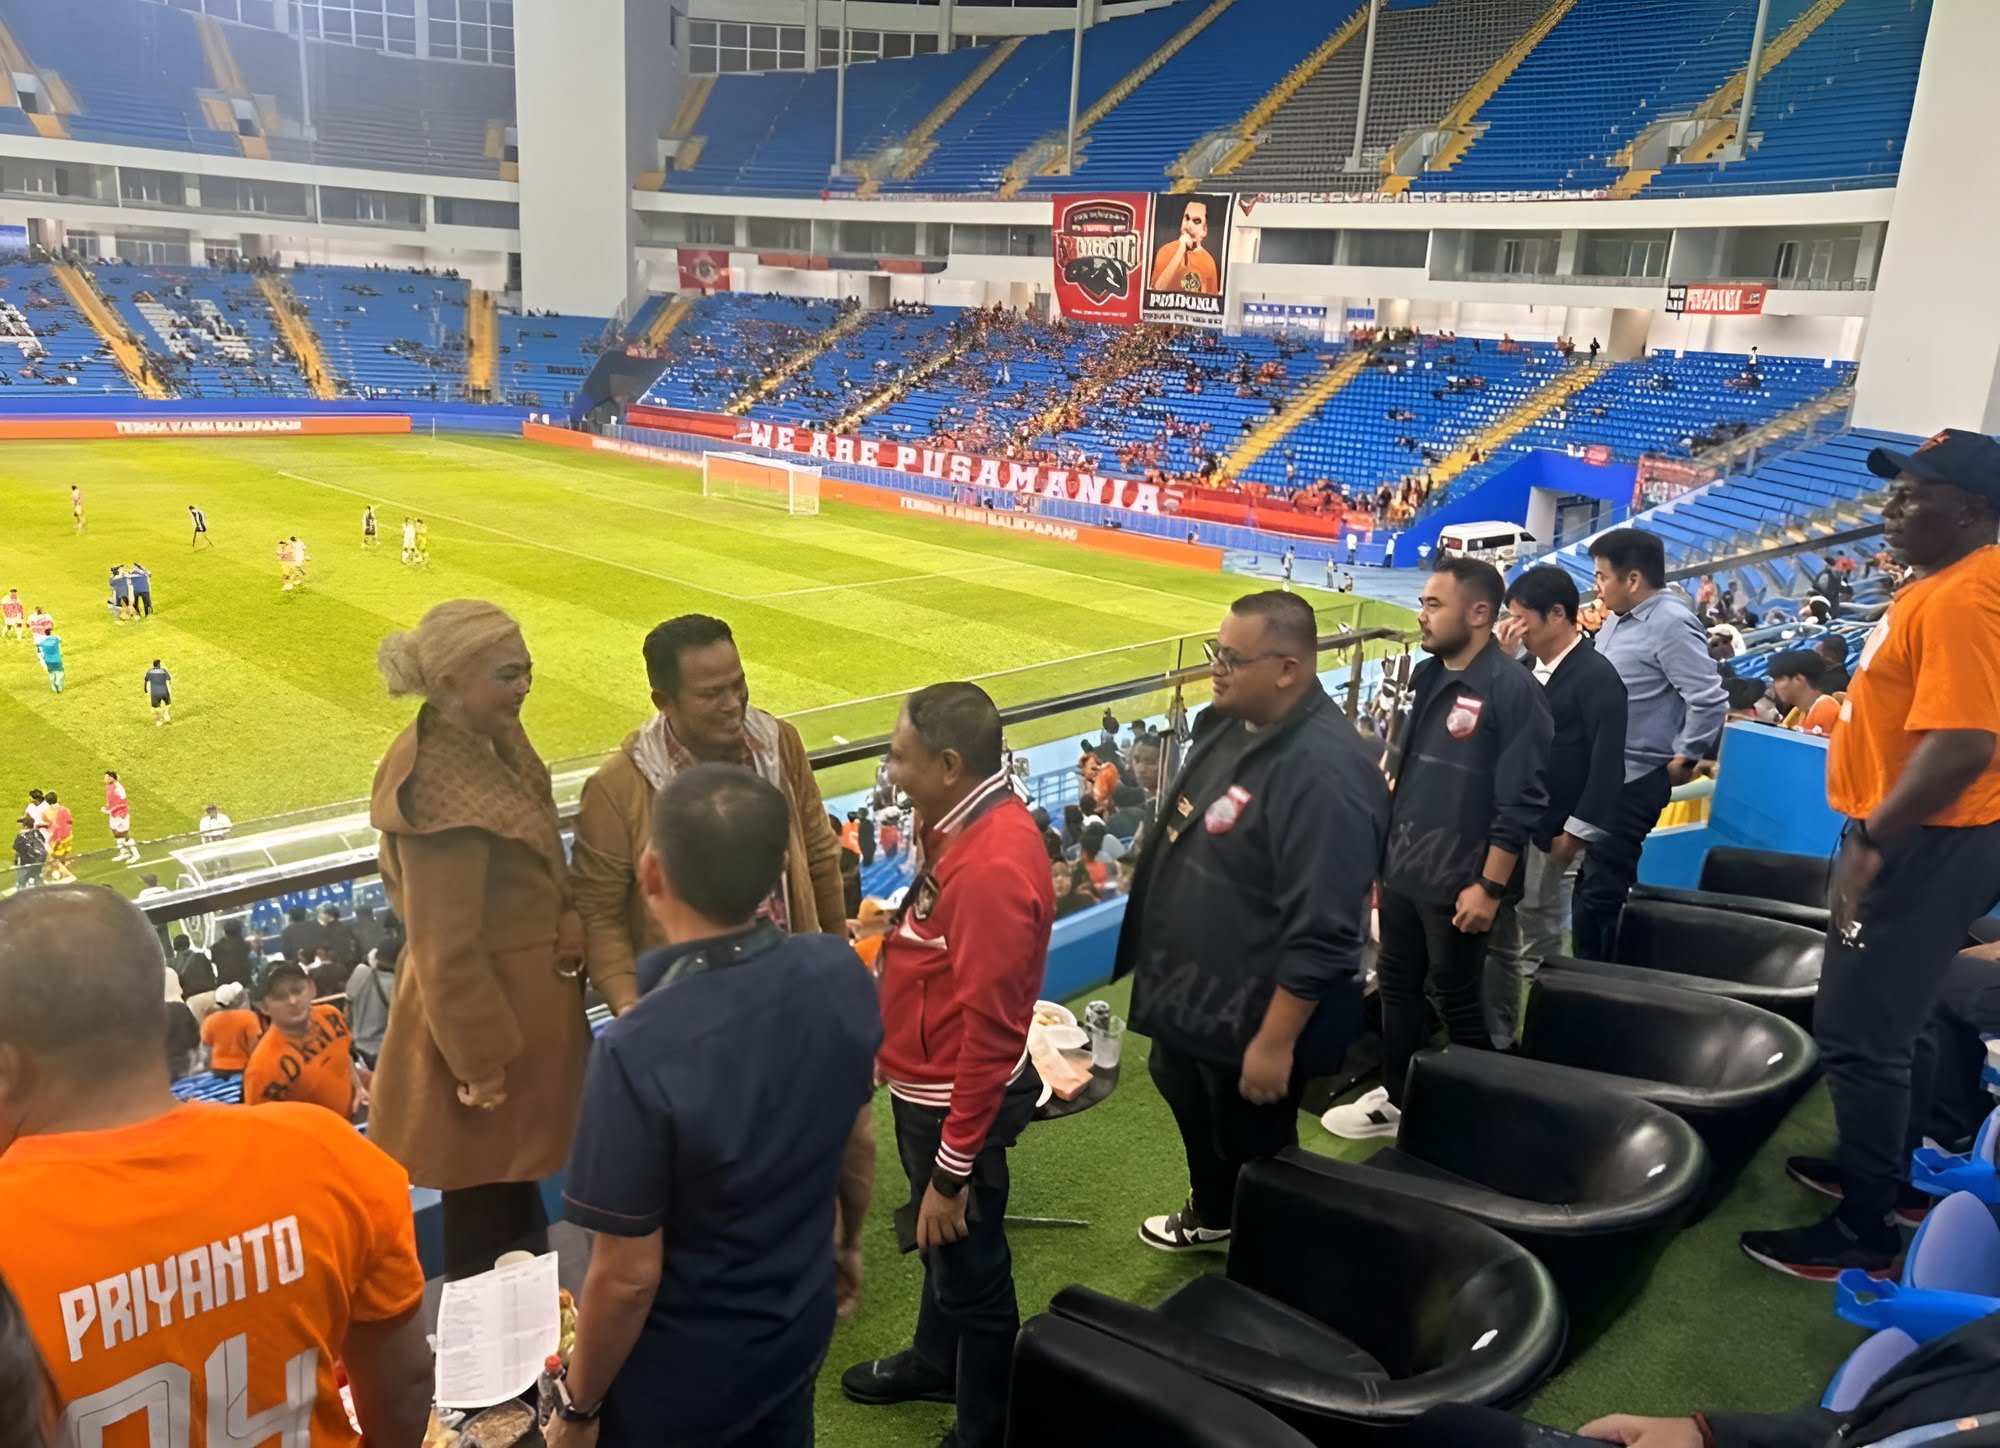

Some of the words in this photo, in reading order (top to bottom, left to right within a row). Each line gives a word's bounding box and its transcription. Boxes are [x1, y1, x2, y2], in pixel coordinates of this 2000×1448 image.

[750, 420, 796, 452] WE
[810, 432, 880, 467] ARE
[895, 446, 1161, 515] PUSAMANIA
[59, 1215, 305, 1362] PRIYANTO
